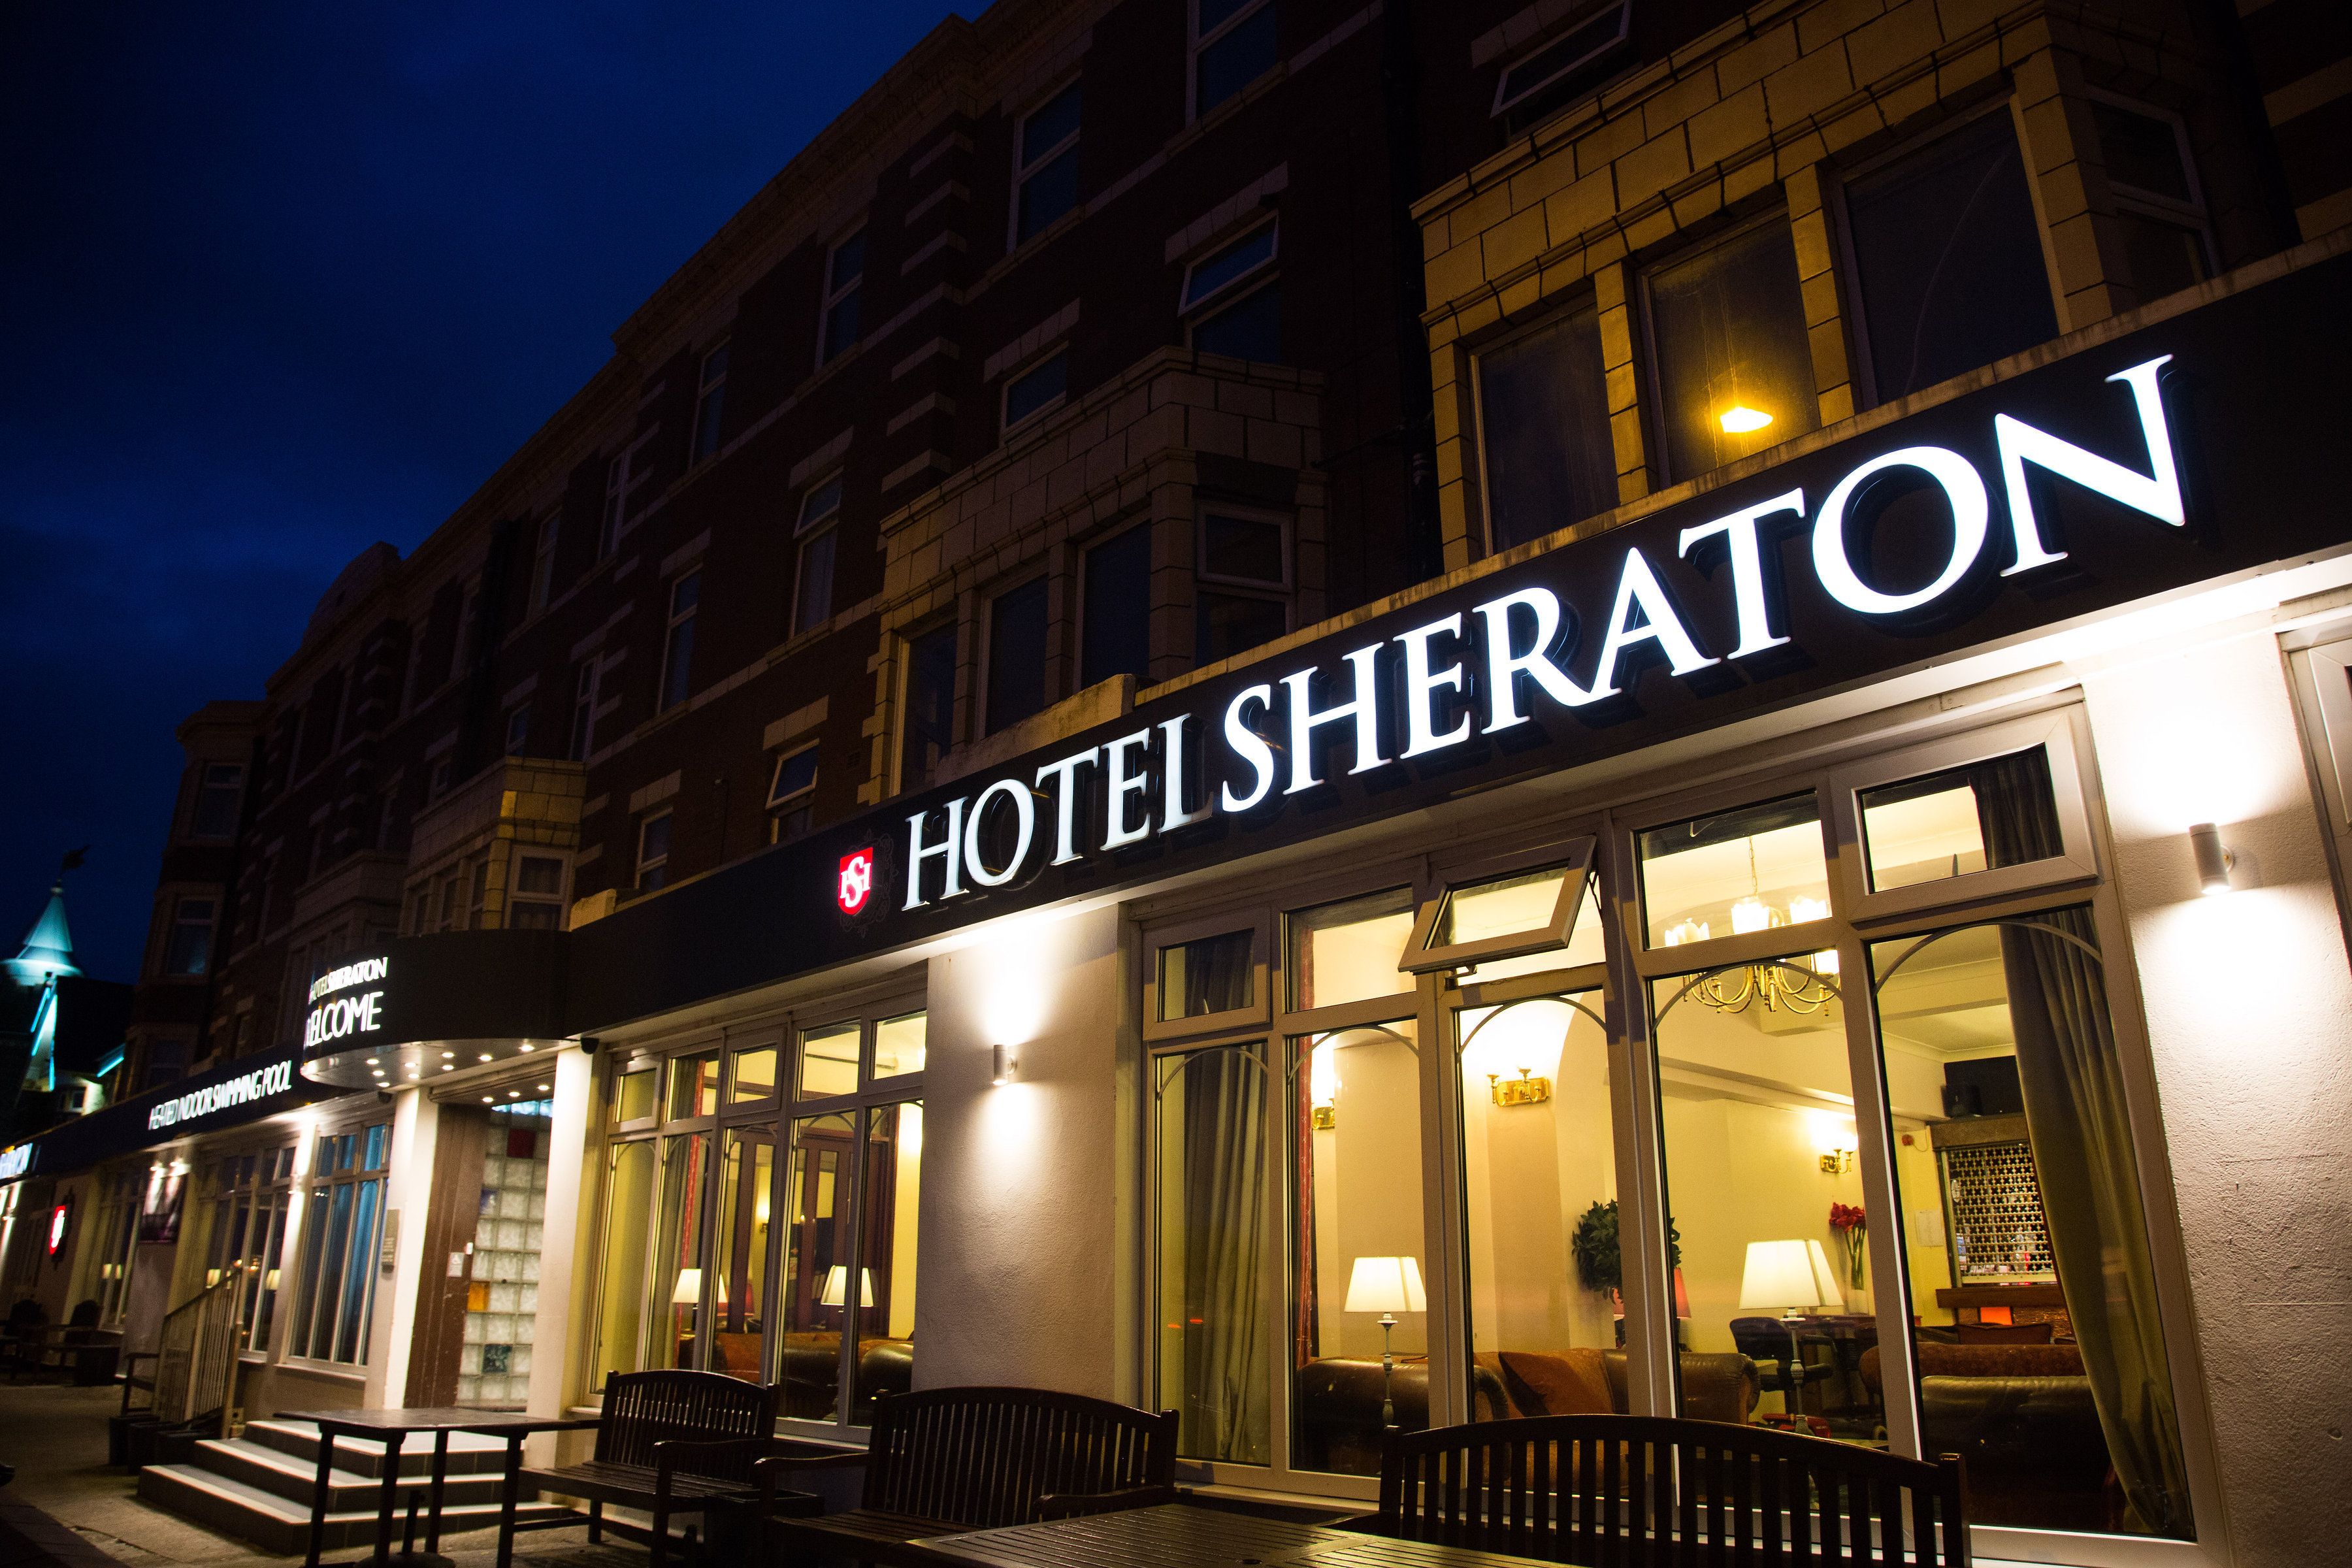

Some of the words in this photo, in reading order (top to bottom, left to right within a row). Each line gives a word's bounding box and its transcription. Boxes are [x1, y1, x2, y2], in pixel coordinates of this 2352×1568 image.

[901, 713, 1213, 911] HOTEL
[1222, 353, 2186, 813] SHERATON
[327, 956, 389, 994] SHERATON
[261, 1060, 292, 1098] POOL
